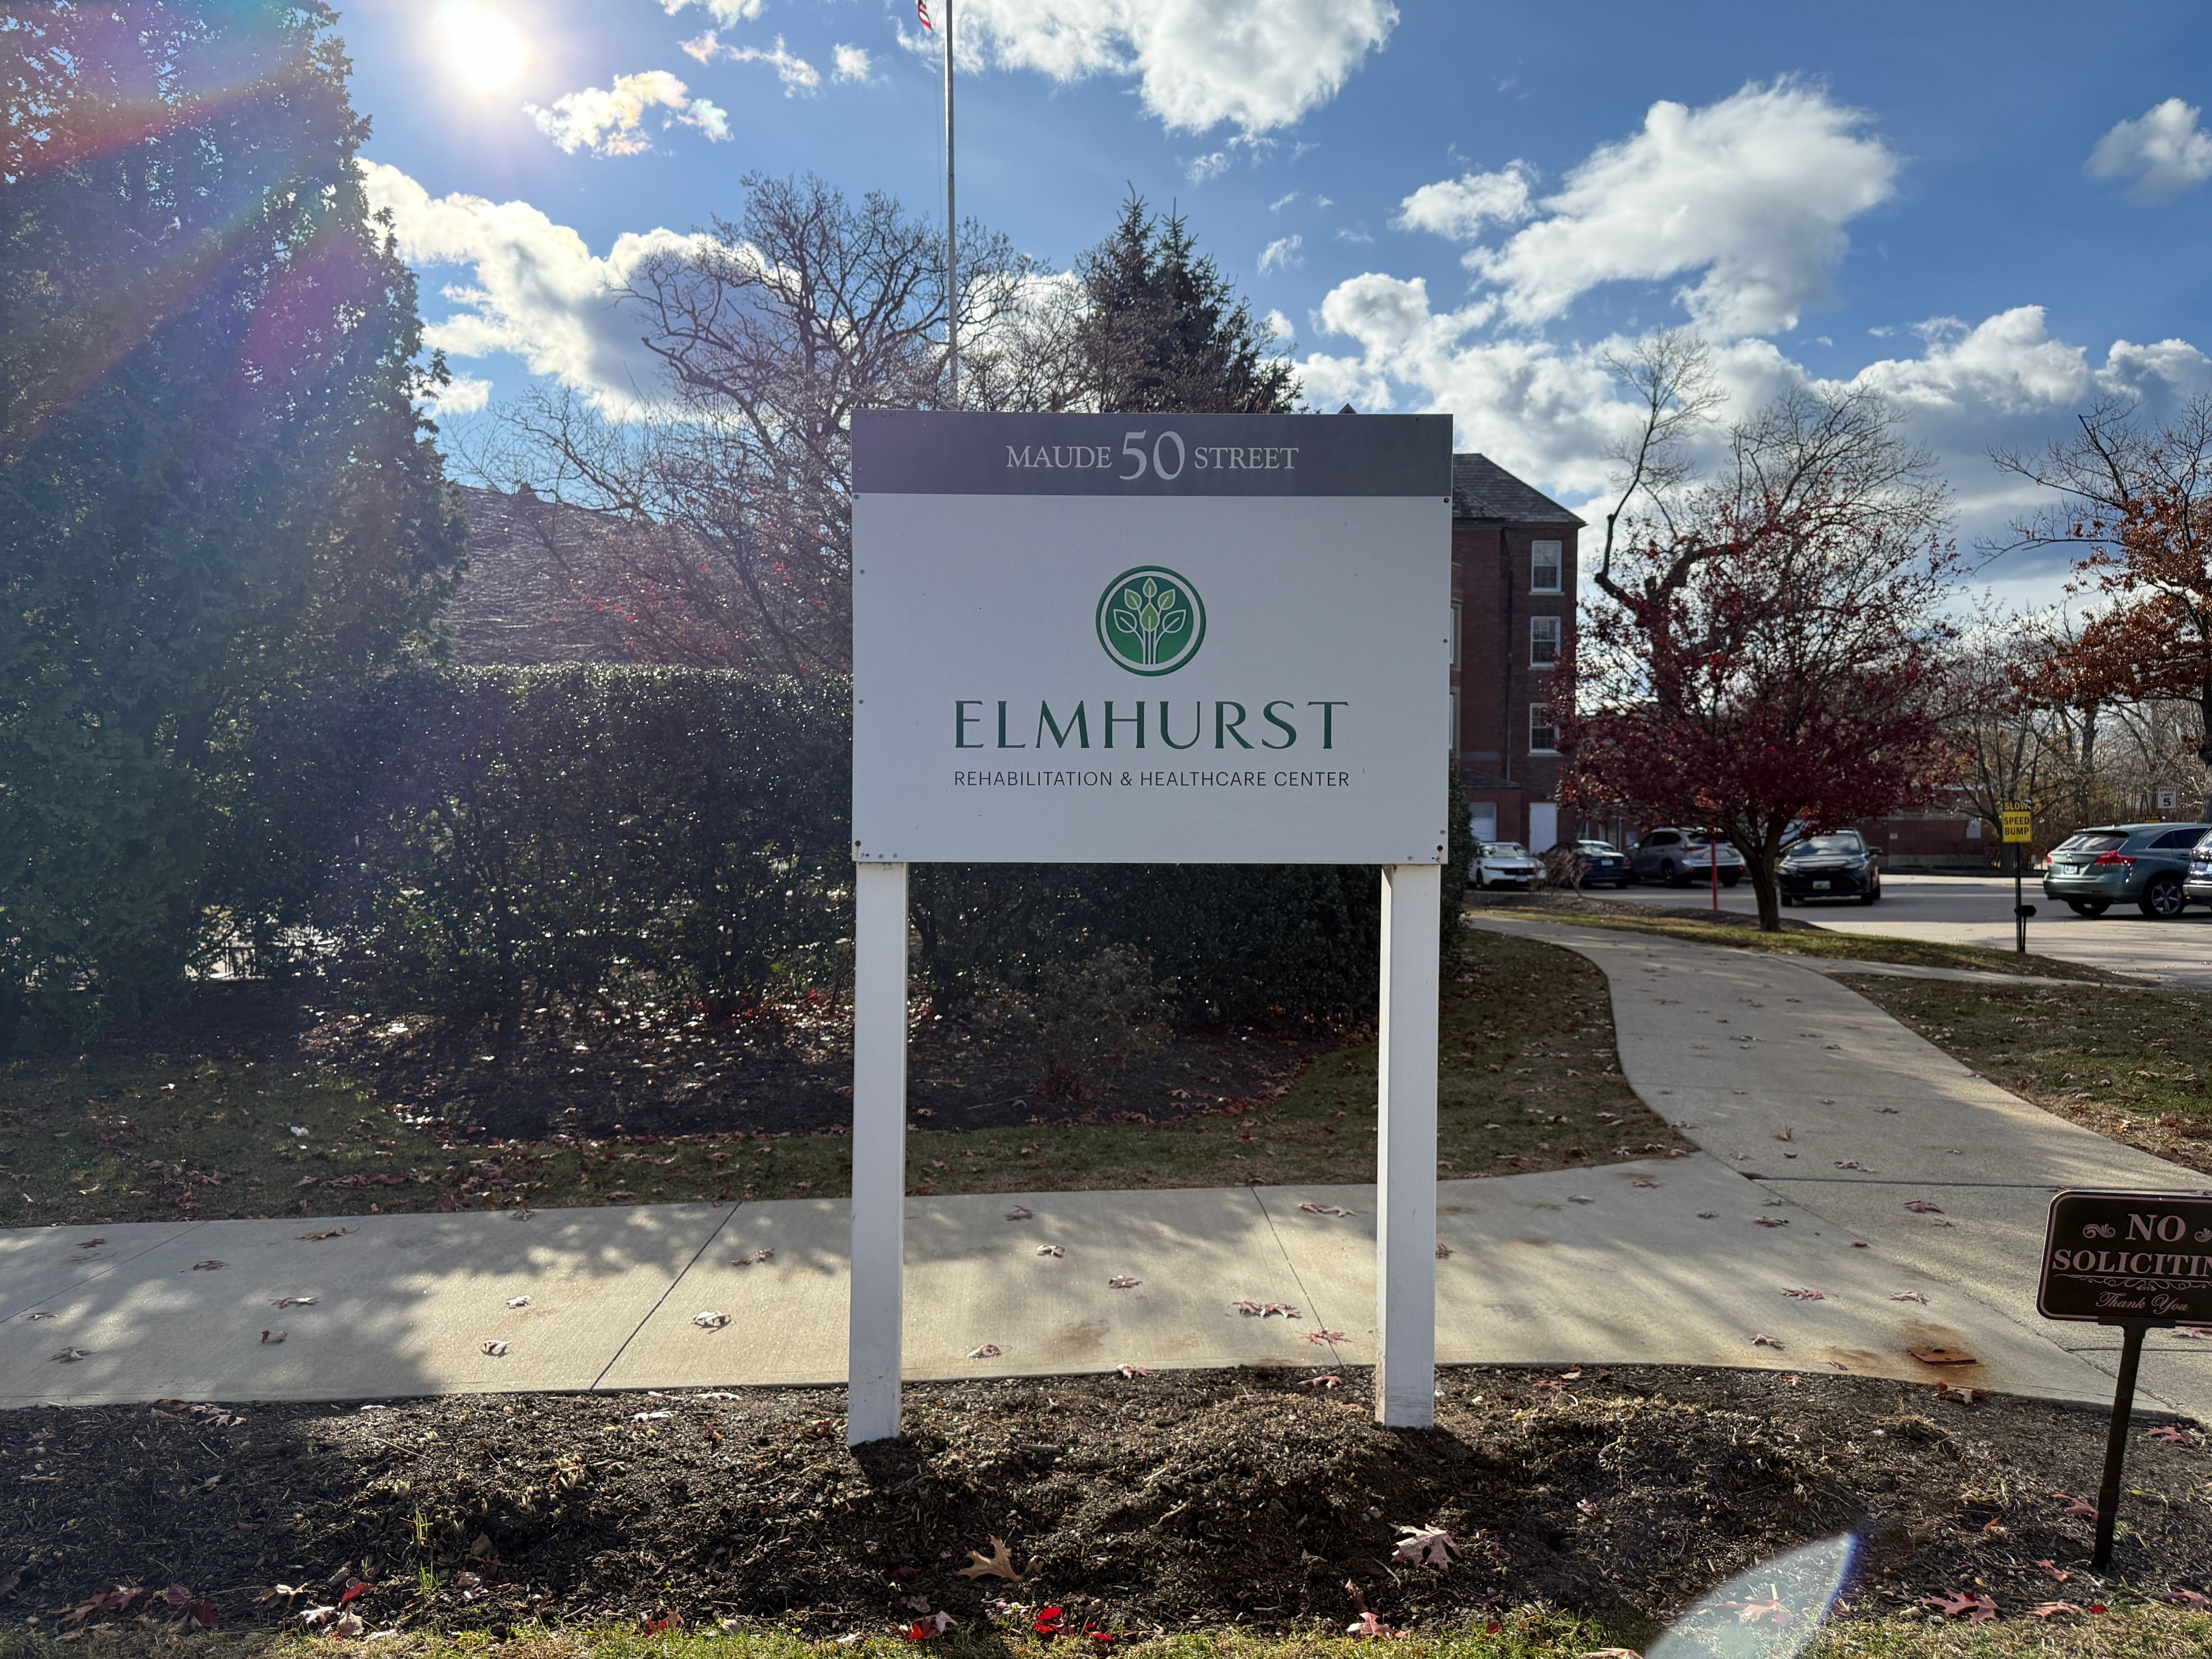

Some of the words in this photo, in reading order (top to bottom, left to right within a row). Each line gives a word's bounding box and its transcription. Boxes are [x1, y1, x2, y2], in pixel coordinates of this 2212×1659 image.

[1005, 445, 1112, 468] MAUDE
[1119, 429, 1185, 480] 50
[1194, 446, 1299, 469] STREET
[955, 699, 1349, 750] ELMHURST
[955, 771, 1112, 787] REHABILITATION
[1120, 771, 1132, 787] &
[1140, 771, 1267, 787] HEALTHCARE
[1274, 771, 1349, 787] CENTER
[2004, 801, 2028, 810] SLOW
[2163, 798, 2171, 806] 5
[2004, 816, 2029, 825] SPEED
[2005, 827, 2029, 835] BUMP
[2124, 1213, 2186, 1242] NO
[2095, 1291, 2145, 1309] Thank
[2151, 1294, 2188, 1315] You
